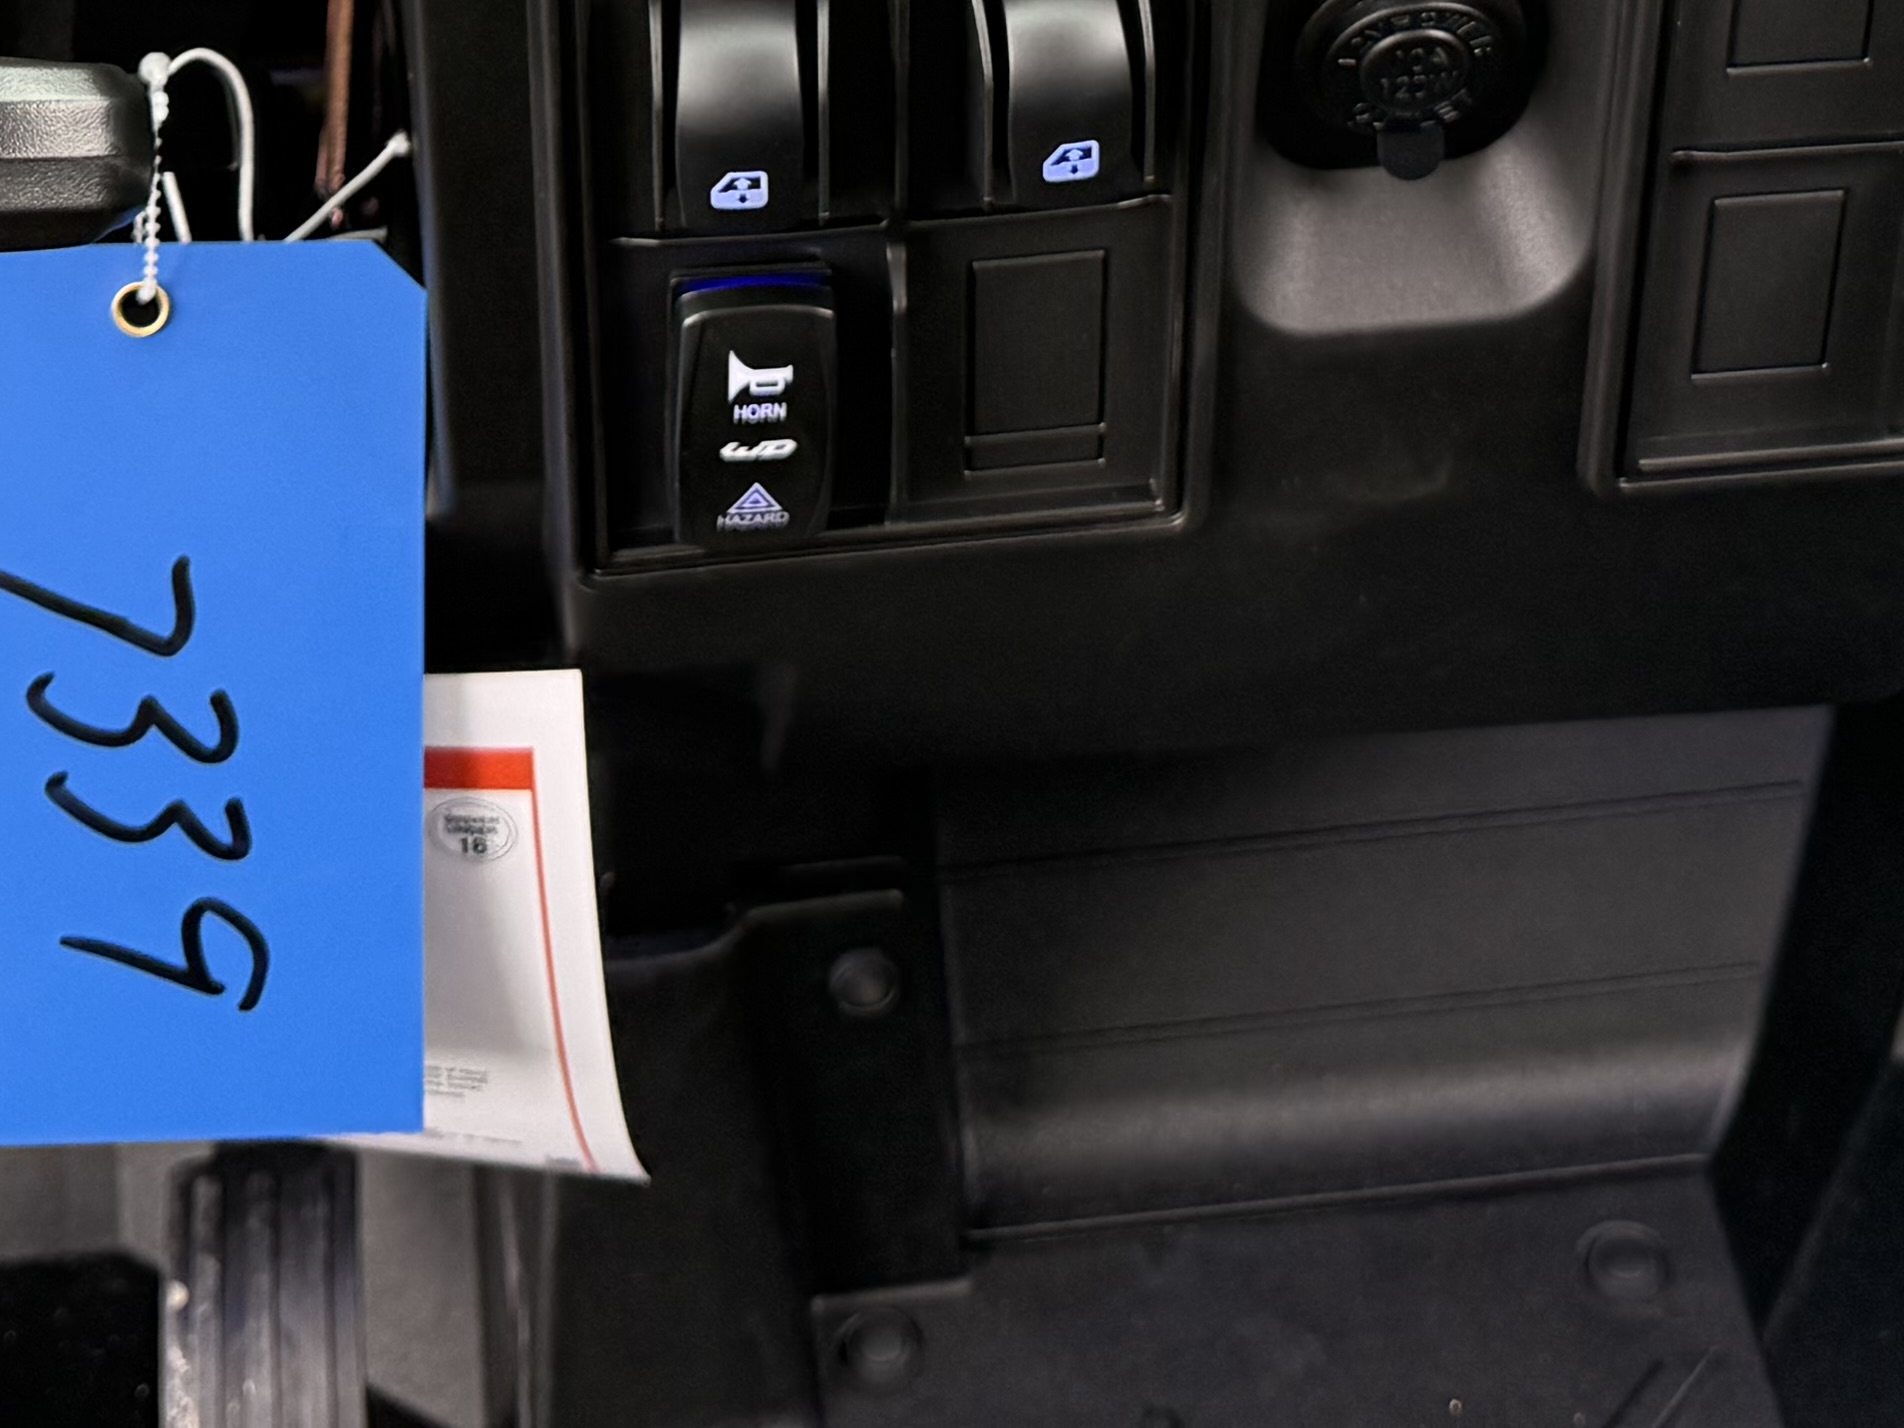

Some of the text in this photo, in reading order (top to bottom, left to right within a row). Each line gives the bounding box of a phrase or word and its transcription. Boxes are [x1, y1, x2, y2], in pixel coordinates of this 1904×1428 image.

[733, 402, 787, 424] HORN
[717, 511, 790, 532] HAZARD
[461, 837, 488, 854] 16
